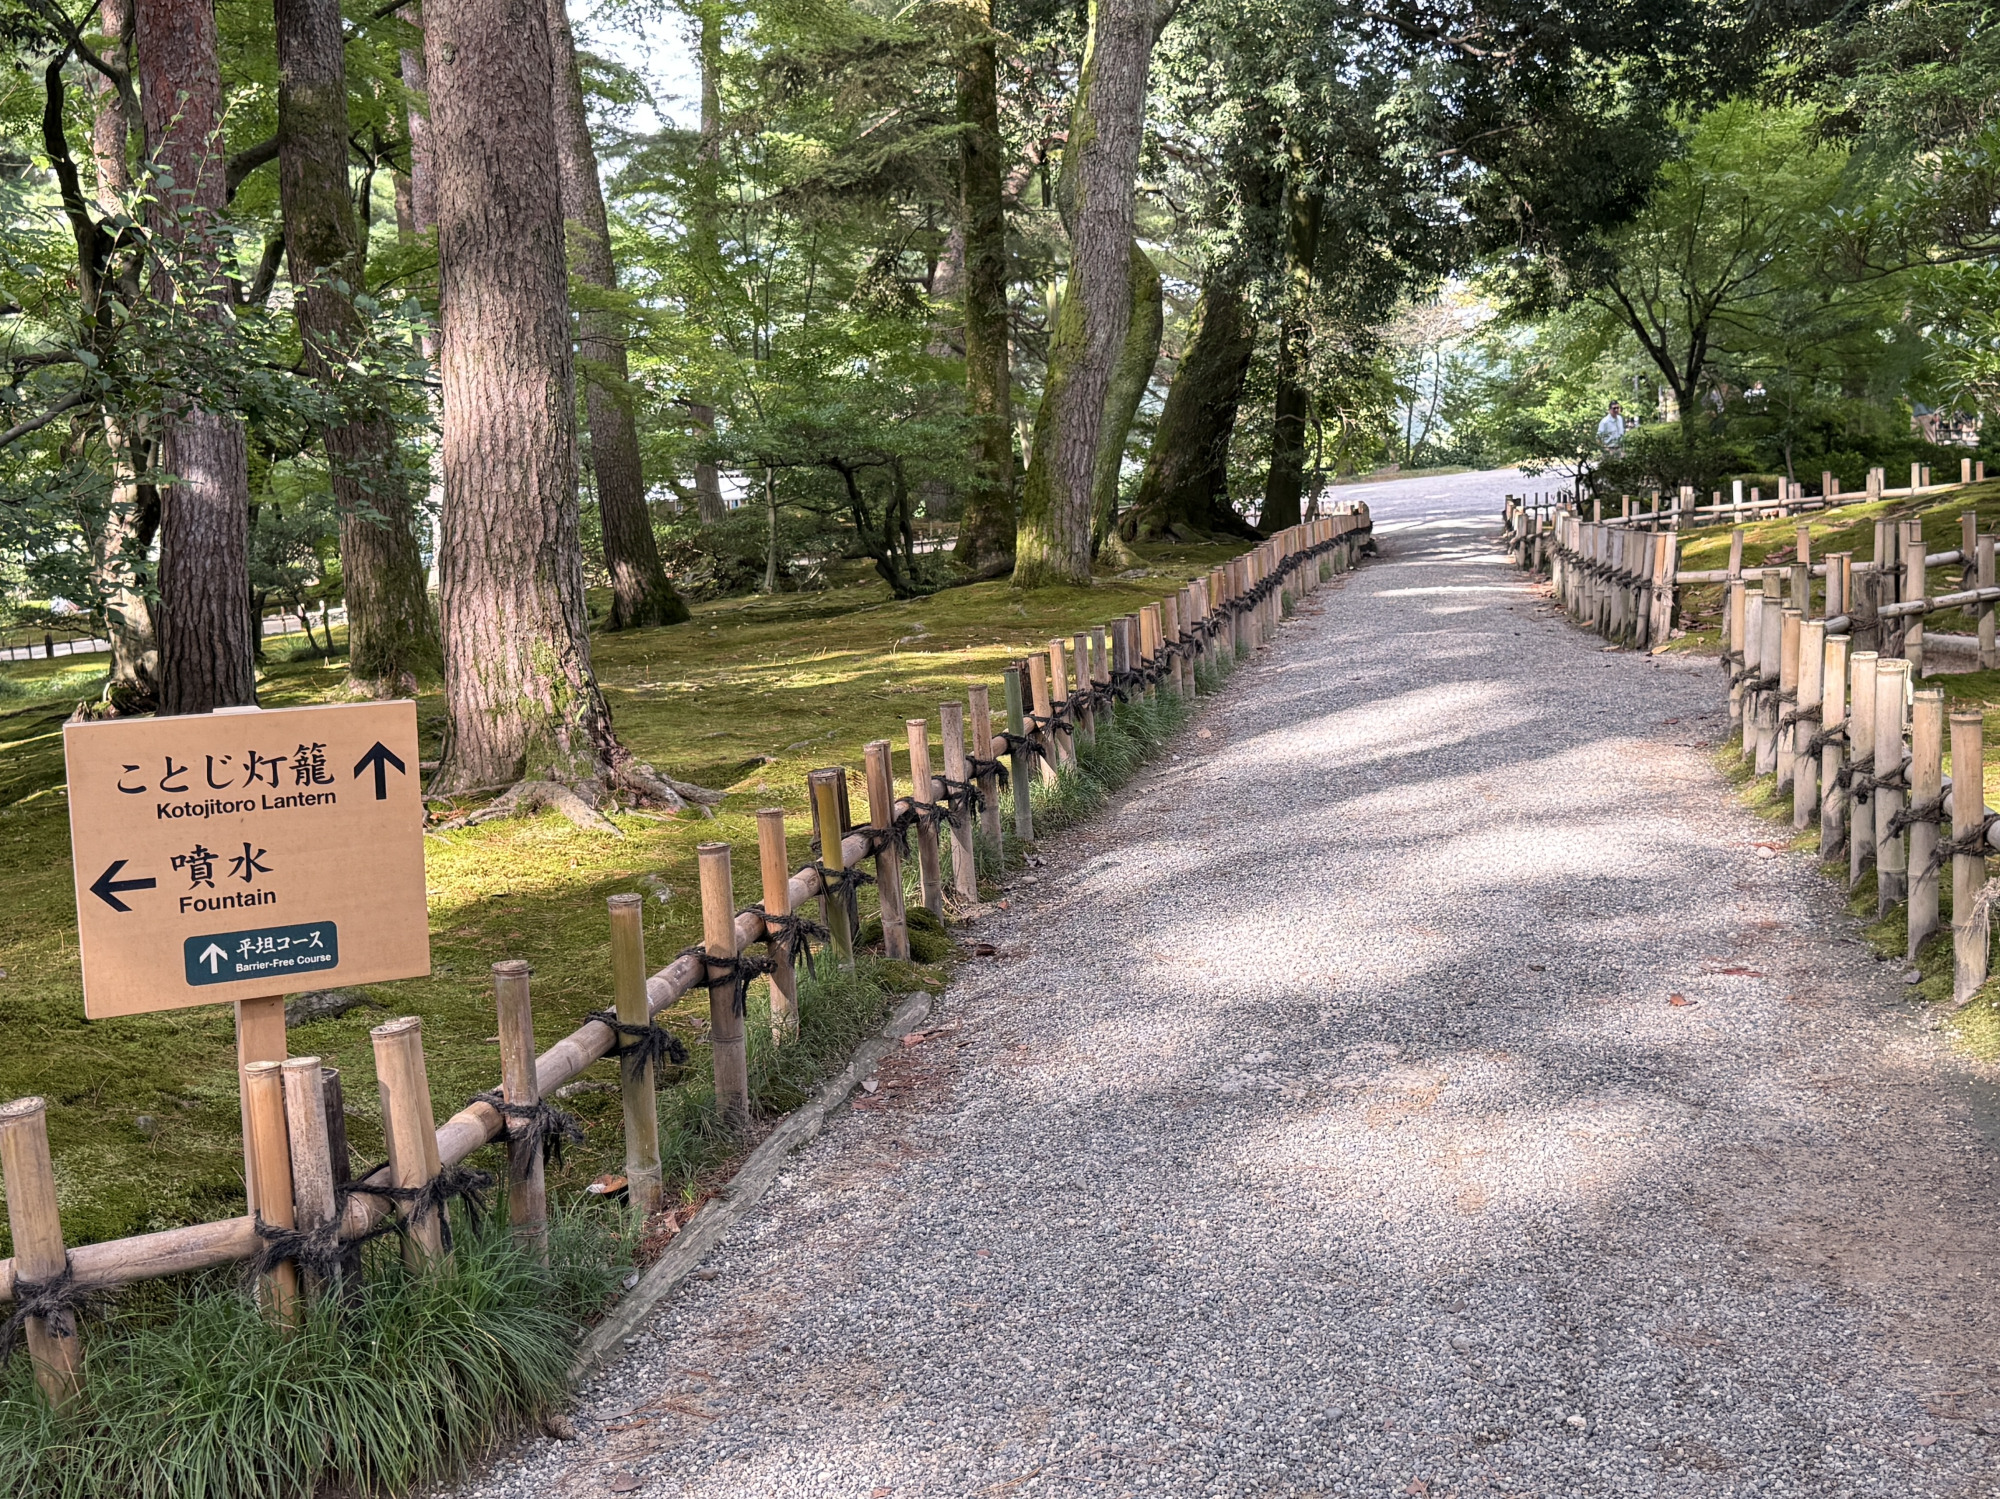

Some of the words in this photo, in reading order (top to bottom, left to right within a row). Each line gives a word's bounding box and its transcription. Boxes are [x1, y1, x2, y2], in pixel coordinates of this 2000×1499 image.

[117, 742, 335, 794] ことじ灯籠
[157, 797, 256, 820] Kotojitoro
[262, 790, 337, 810] Lantern
[170, 842, 274, 890] 噴水
[179, 888, 277, 913] Fountain
[235, 930, 324, 960] 平坦コース
[235, 957, 295, 973] Barrier-Free
[296, 954, 331, 965] Course
